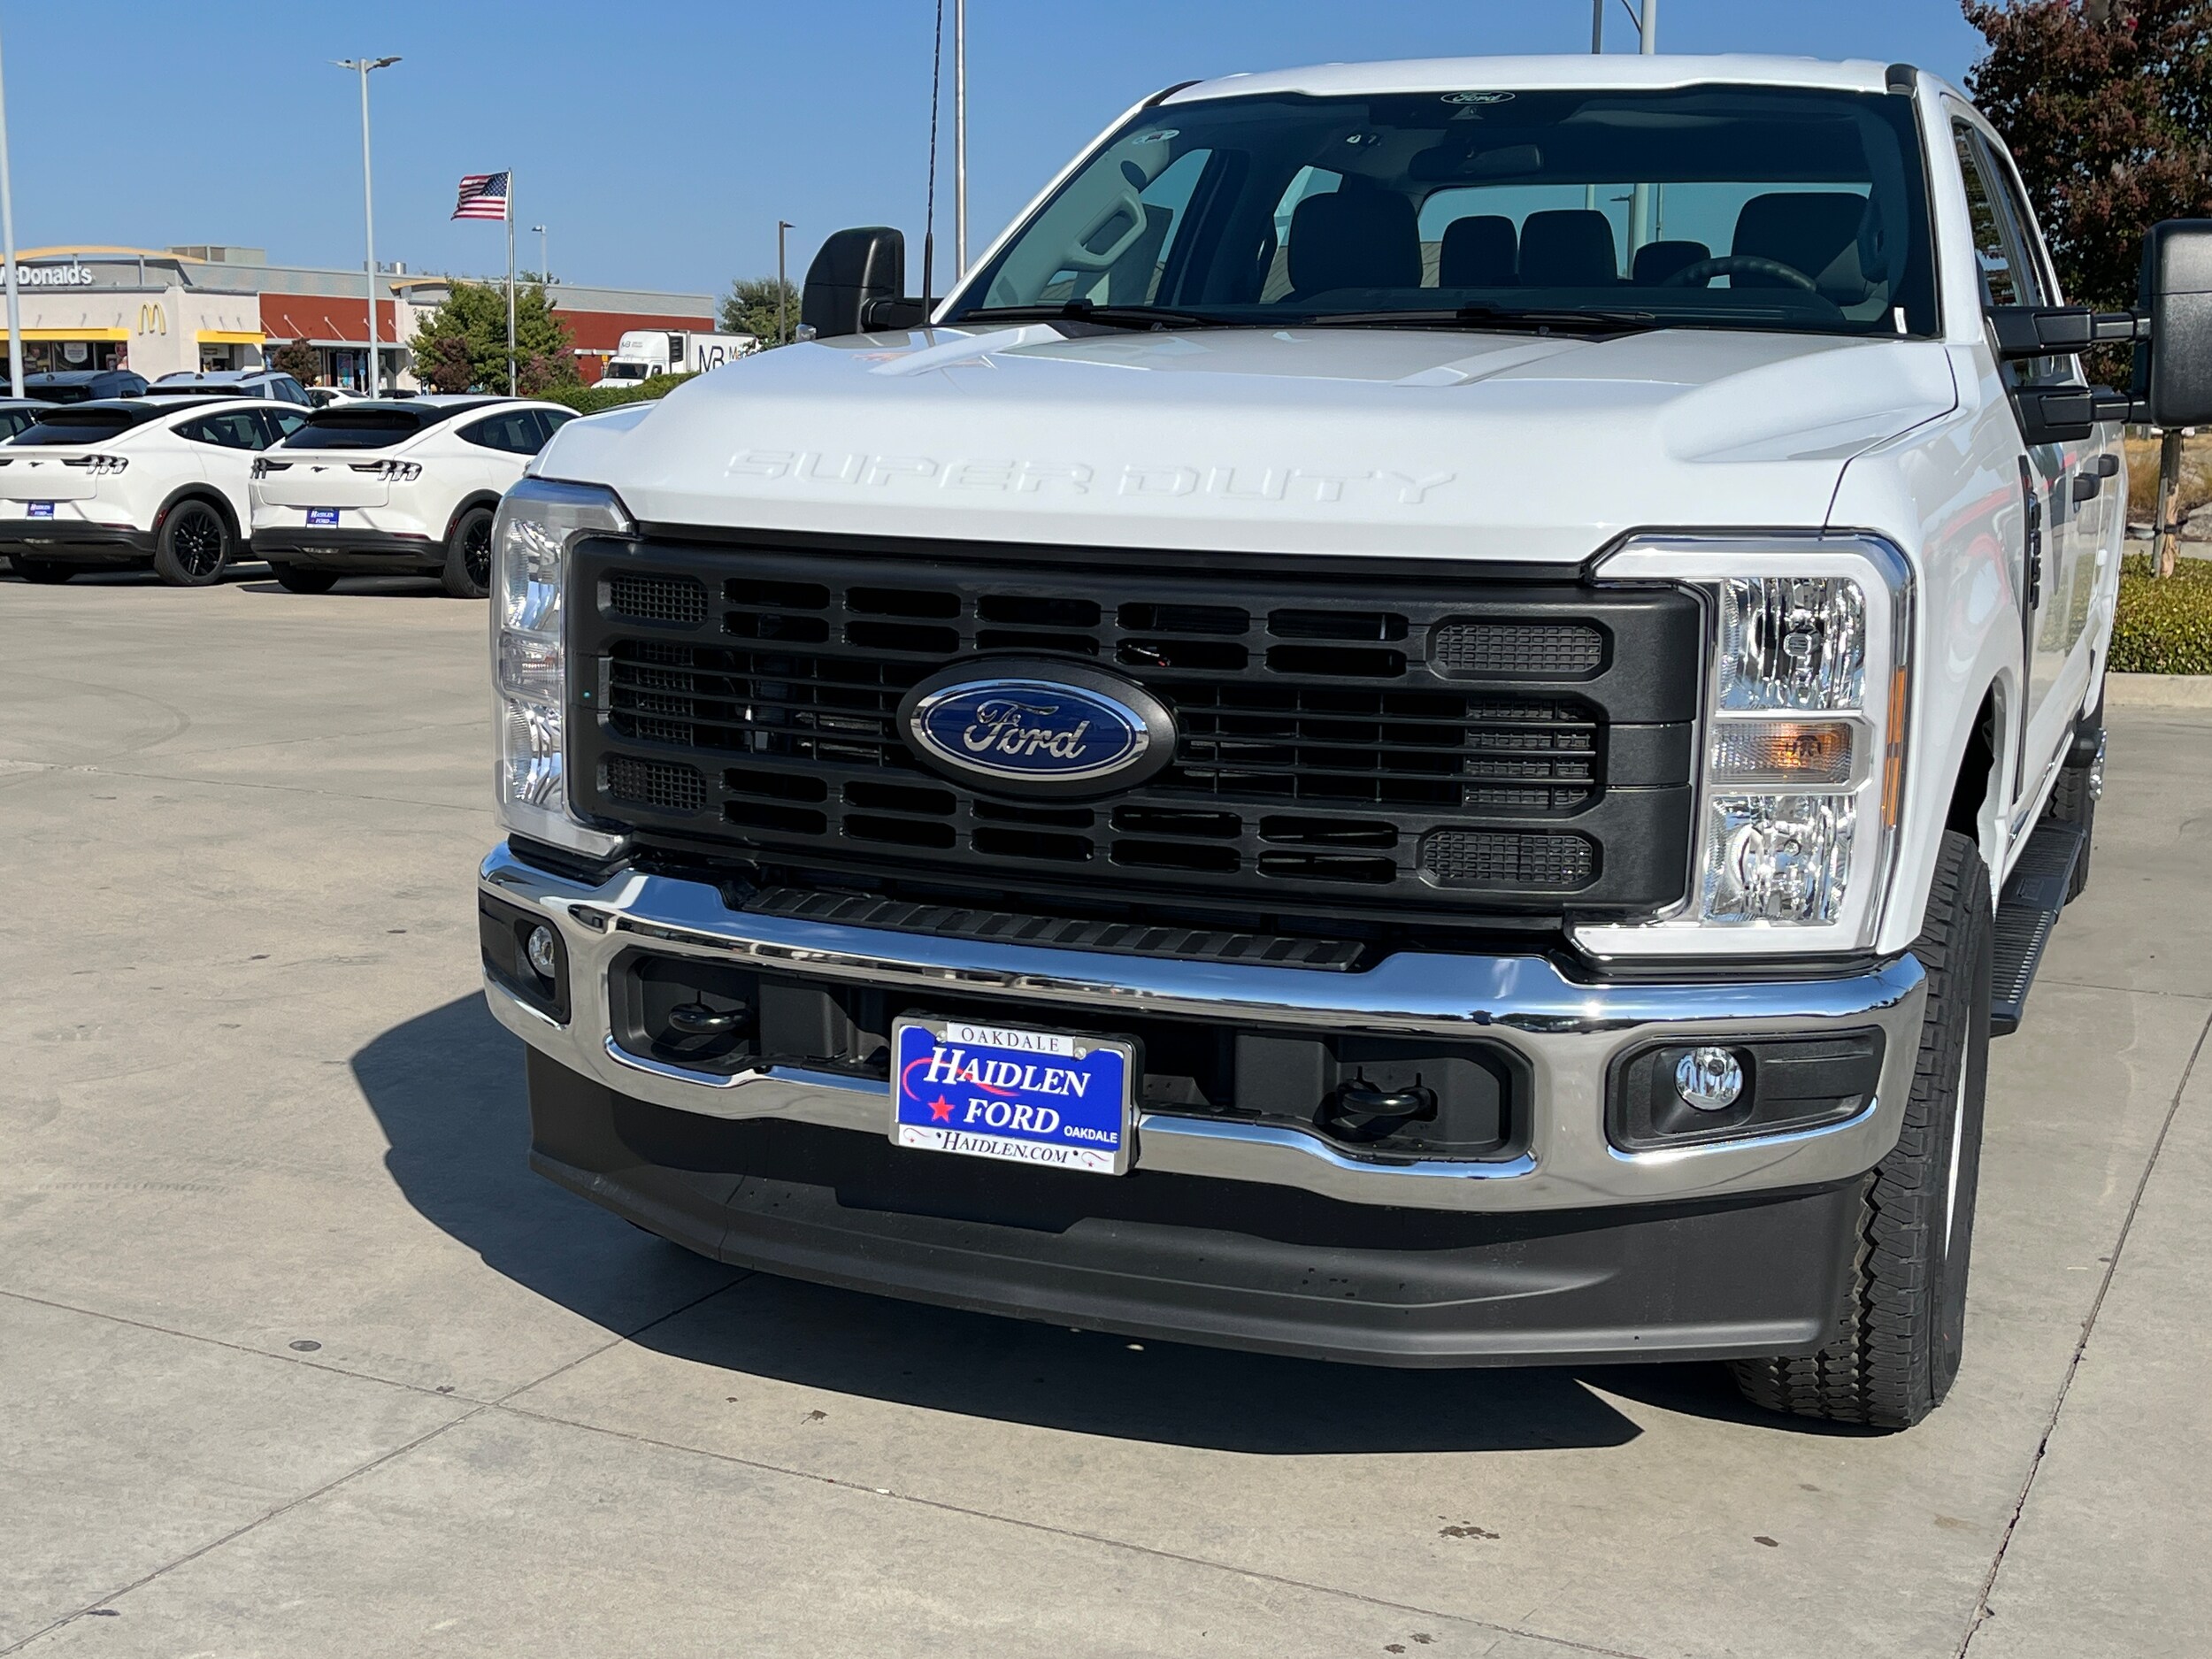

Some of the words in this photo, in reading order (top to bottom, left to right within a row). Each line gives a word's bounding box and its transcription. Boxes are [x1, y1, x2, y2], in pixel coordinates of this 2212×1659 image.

[724, 449, 1095, 495] SUPER
[1118, 464, 1457, 504] DUTY
[963, 699, 1091, 759] Ford
[961, 1026, 1060, 1053] OAKDALE
[923, 1046, 1091, 1098] HAIDLEN
[963, 1097, 1060, 1134] FORD
[941, 1130, 1069, 1164] HAIDLEN.COM
[1064, 1125, 1118, 1144] OAKDALE
